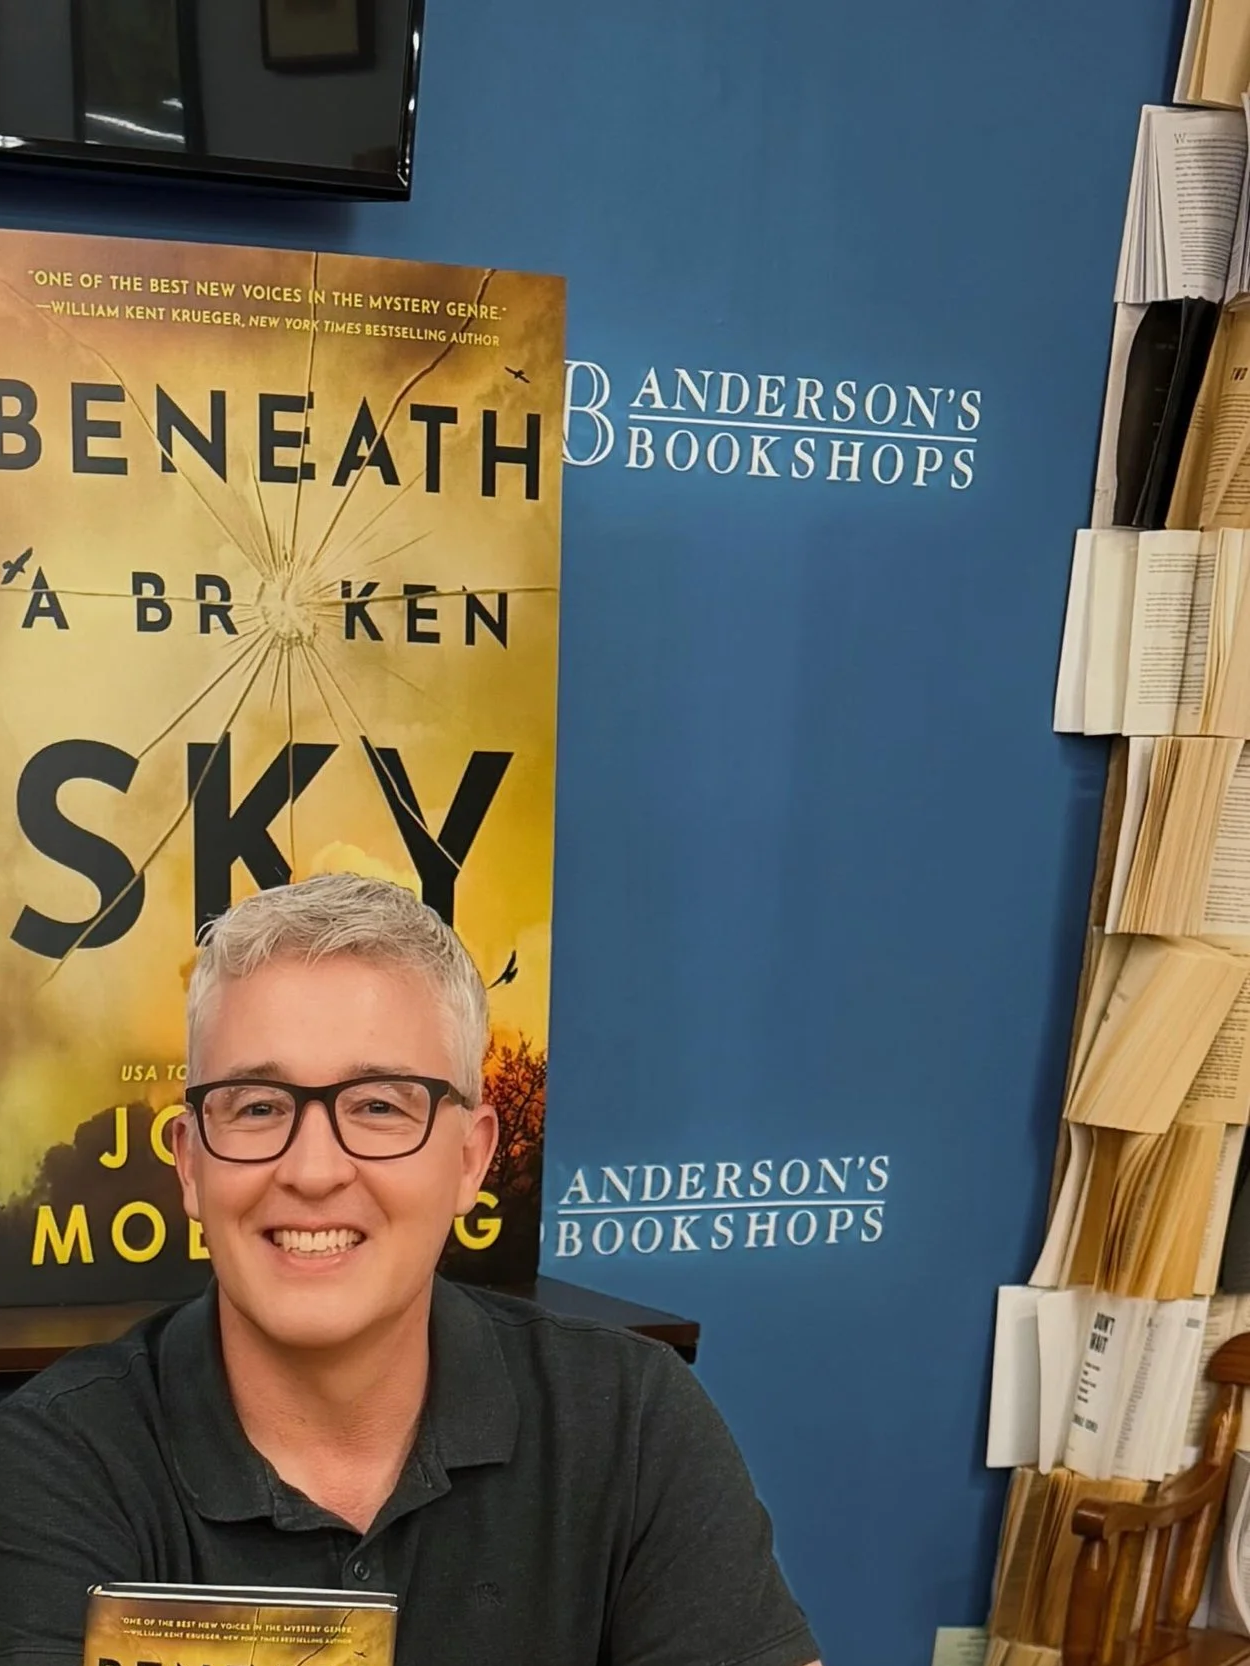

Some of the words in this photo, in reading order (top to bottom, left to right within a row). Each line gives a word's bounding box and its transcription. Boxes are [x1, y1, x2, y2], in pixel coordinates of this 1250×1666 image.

[80, 273, 103, 290] OF
[109, 275, 142, 292] THE
[150, 278, 188, 295] BEST
[196, 280, 235, 298] NEW
[242, 282, 302, 303] VOICES
[309, 287, 326, 305] IN
[333, 290, 363, 308] THE
[369, 293, 441, 316] MYSTERY
[125, 305, 165, 321] KENT
[171, 308, 246, 328] KRUEGER,
[250, 315, 279, 328] NEW
[285, 316, 319, 332] YORK
[323, 319, 362, 335] TIMES
[365, 322, 446, 342] BESTSELLING
[450, 329, 500, 347] AUTHOR
[631, 367, 982, 433] ANDERSON'S
[625, 427, 976, 490] BOOKSHOPS
[22, 567, 69, 630] A
[10, 732, 515, 959] SKY
[121, 1064, 158, 1081] USA
[558, 1155, 890, 1205] ANDERSON'S
[555, 1206, 885, 1258] BOOKSHOPS
[144, 1618, 156, 1626] OF
[158, 1619, 174, 1627] THE
[176, 1620, 196, 1628] BEST
[198, 1621, 218, 1629] NEW
[221, 1622, 250, 1631] VOICES
[265, 1624, 281, 1632] THE
[283, 1625, 322, 1633] MYSTERY
